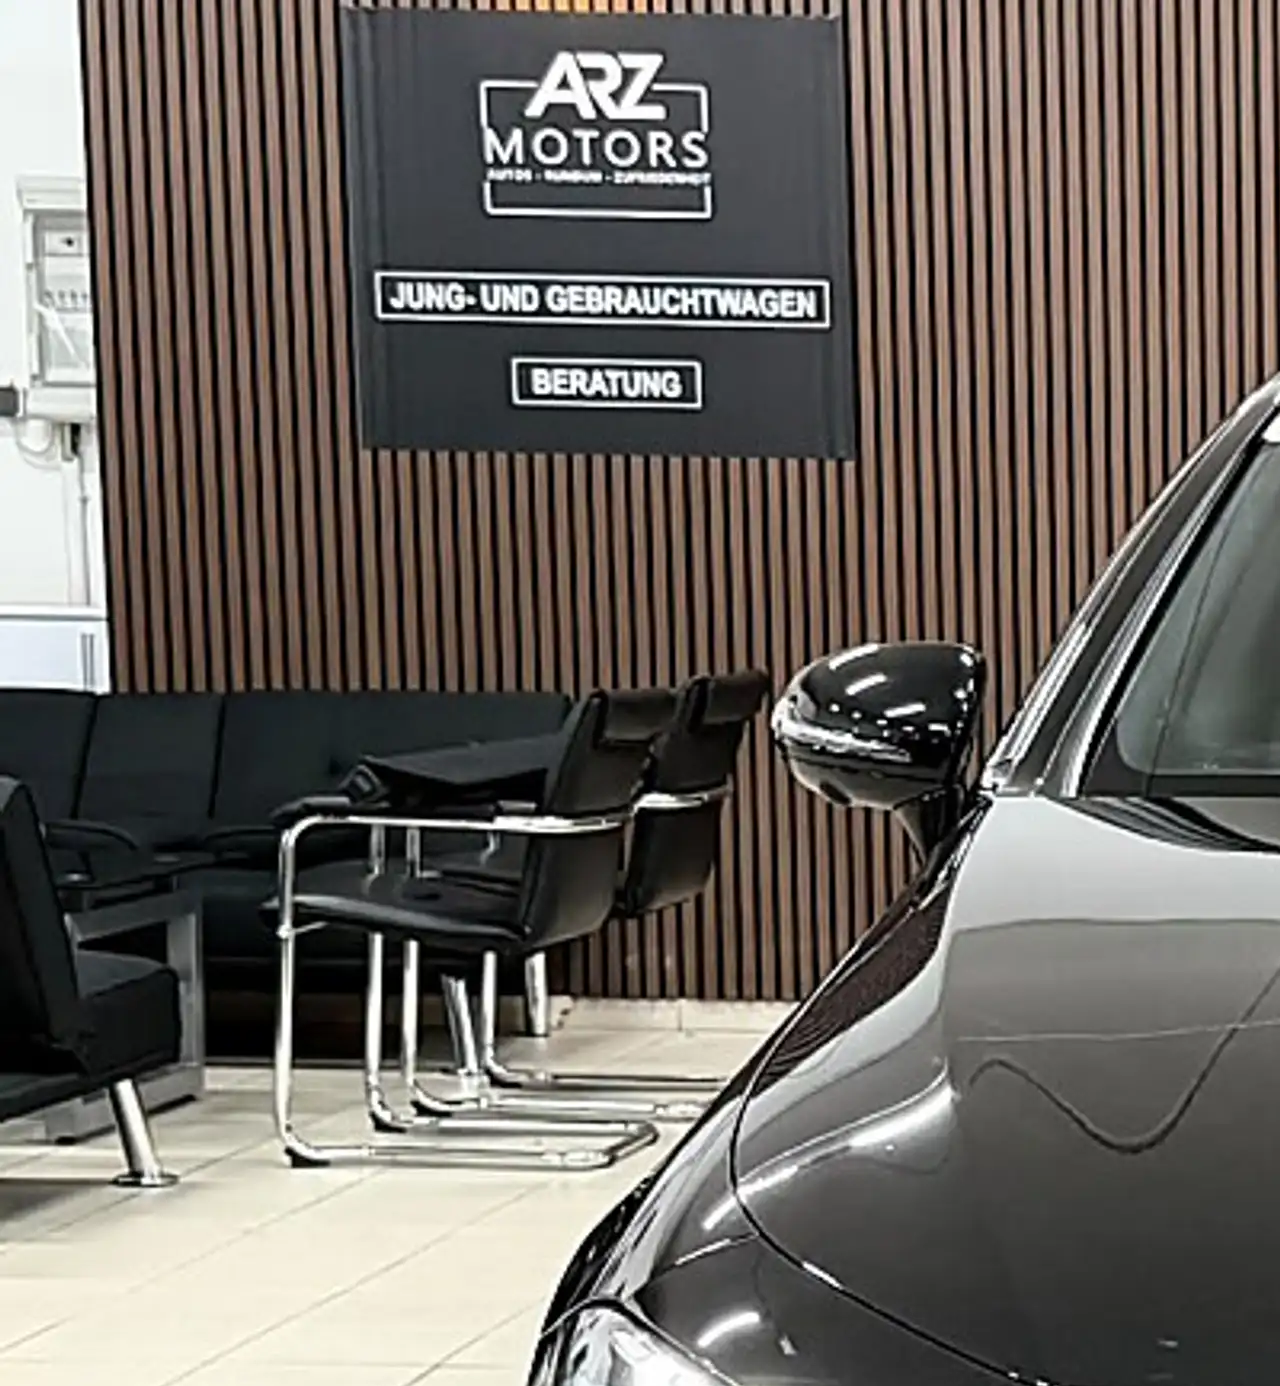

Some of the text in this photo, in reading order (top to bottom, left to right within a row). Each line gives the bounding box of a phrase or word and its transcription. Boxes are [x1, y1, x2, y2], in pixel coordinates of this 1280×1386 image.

[524, 51, 666, 120] ARZ
[485, 128, 708, 169] MOTORS
[389, 281, 817, 319] JUNG- UND GEBRAUCHTWAGEN
[531, 367, 683, 399] BERATUNG
